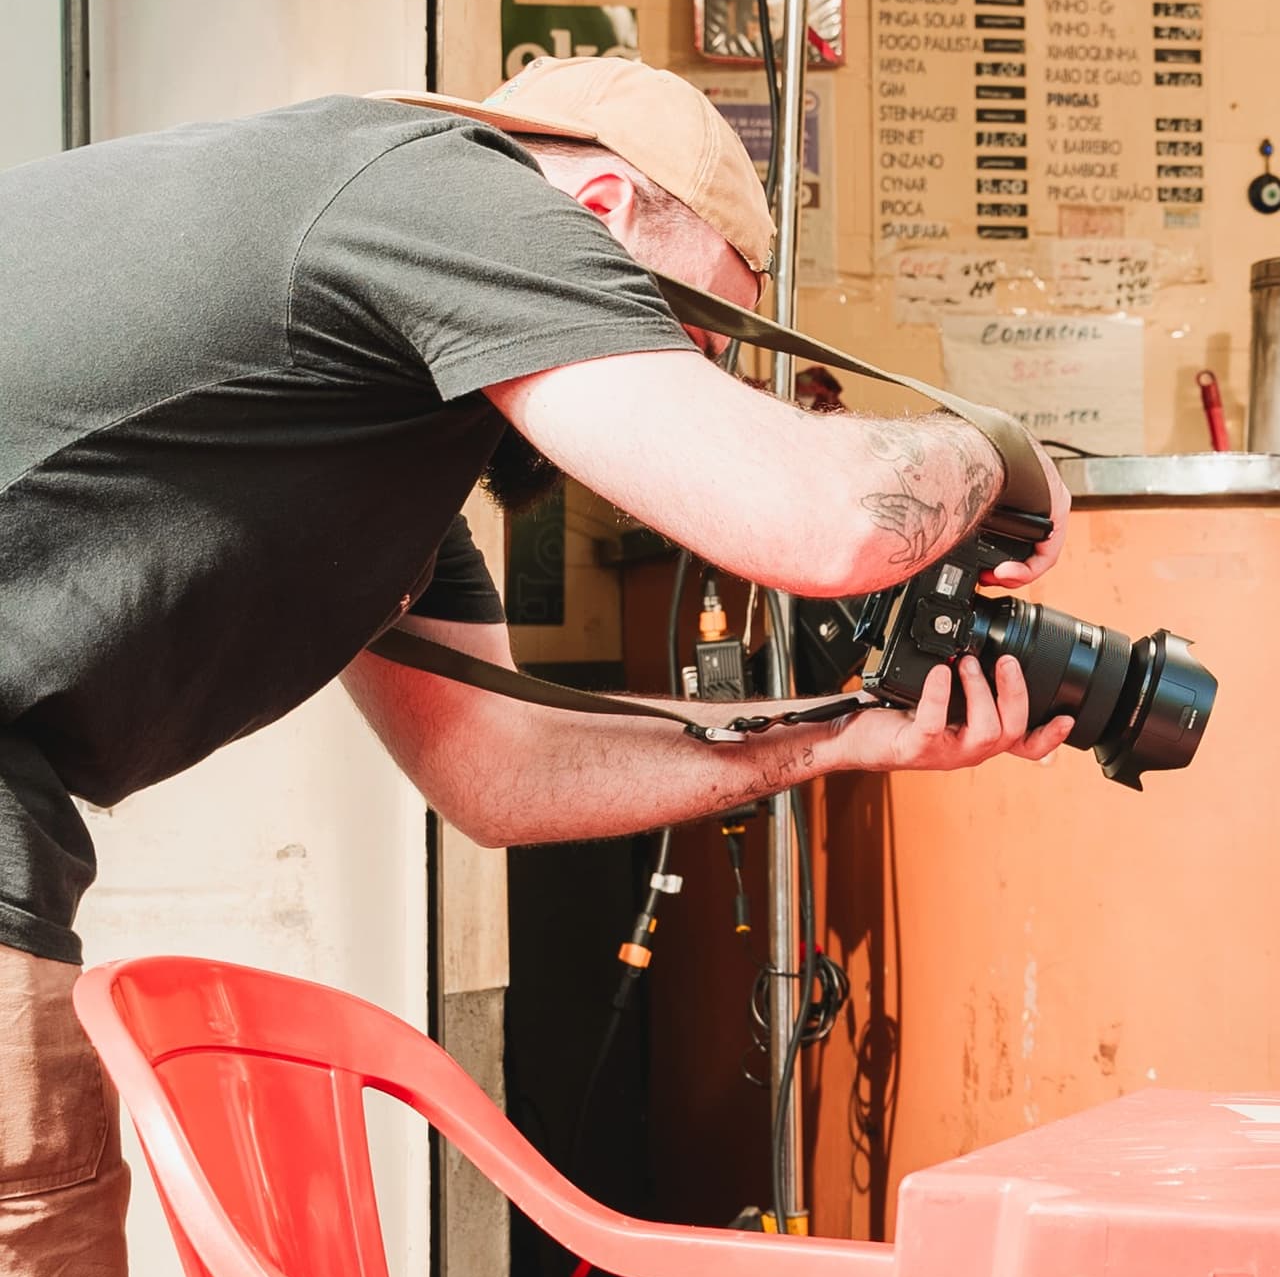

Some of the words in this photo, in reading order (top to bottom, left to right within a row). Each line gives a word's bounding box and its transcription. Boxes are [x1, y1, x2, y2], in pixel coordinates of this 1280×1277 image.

[880, 10, 919, 27] PINGA
[1047, 21, 1089, 38] VINHO
[879, 34, 921, 50] FOGO
[925, 35, 982, 53] PAULISTA
[879, 57, 926, 74] MENTA
[1046, 68, 1082, 84] RABO
[1085, 69, 1100, 84] DE
[1104, 69, 1142, 85] GALO
[879, 81, 905, 98] GIM
[1047, 92, 1099, 108] PINGAS
[1068, 116, 1103, 132] DOSE
[880, 129, 924, 145] FERNET
[881, 153, 945, 170] CINZANO
[1046, 163, 1119, 179] ALAMBIQUE
[881, 176, 927, 192] CYNAR
[1048, 185, 1088, 202] PINGA
[981, 323, 1102, 346] COMERCIAL
